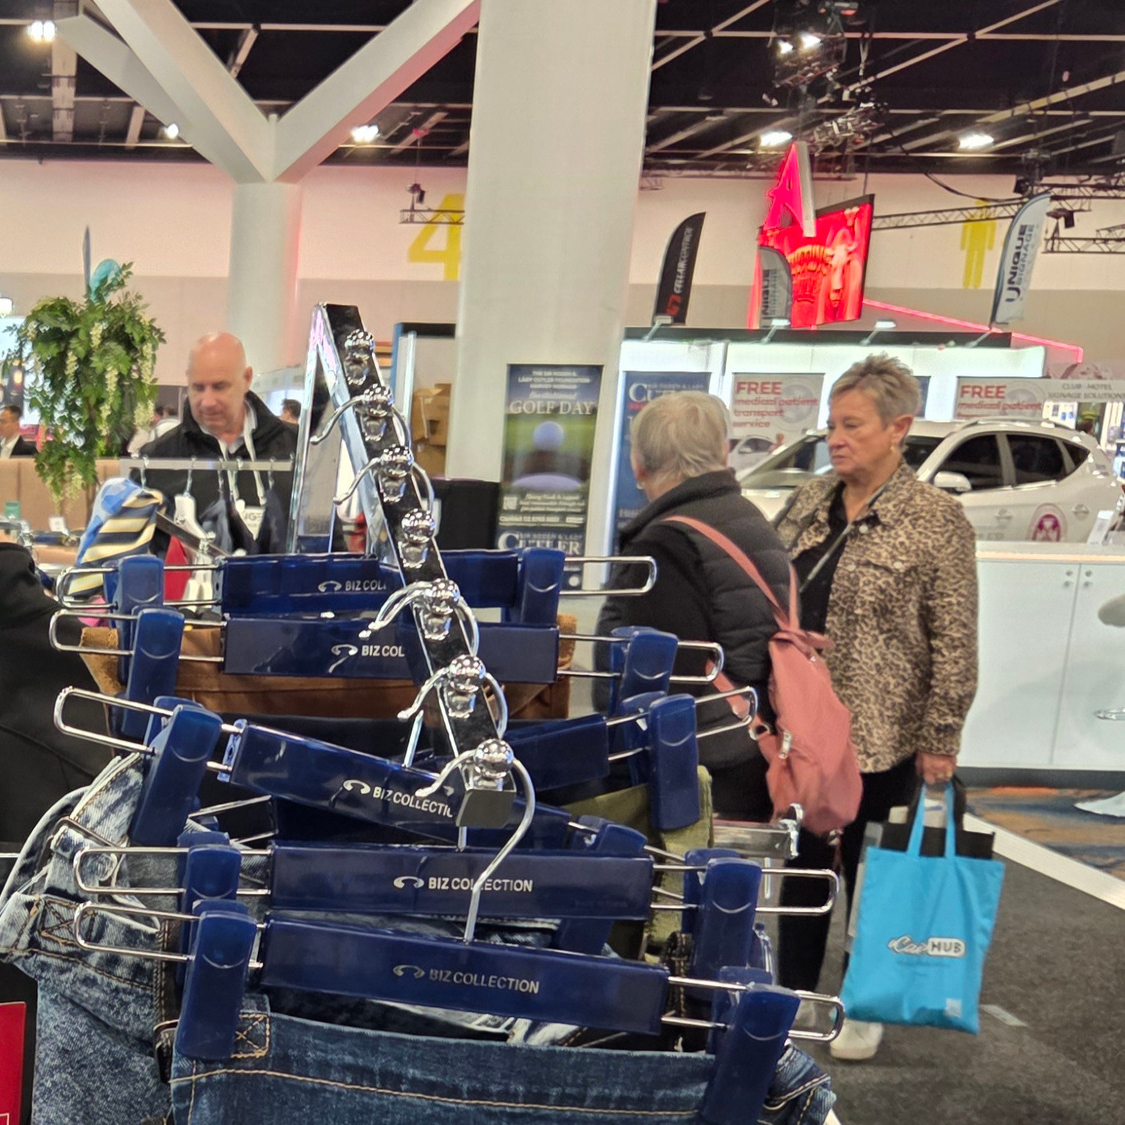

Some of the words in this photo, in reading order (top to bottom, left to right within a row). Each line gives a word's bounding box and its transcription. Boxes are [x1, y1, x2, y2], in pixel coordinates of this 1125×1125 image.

[408, 193, 466, 281] 4
[1016, 224, 1034, 285] SIGNAGE
[1005, 224, 1027, 303] UNIQUE
[736, 381, 783, 395] FREE
[960, 385, 1007, 399] FREE
[509, 400, 555, 415] GOLF
[559, 401, 595, 415] DAY
[734, 396, 776, 406] medical
[778, 397, 819, 408] patient
[957, 402, 1001, 411] medical
[1001, 402, 1042, 412] patient
[733, 409, 784, 418] transport
[732, 419, 771, 427] service
[345, 580, 361, 591] BIZ
[361, 645, 380, 656] BIZ
[373, 786, 393, 801] BIZ
[393, 791, 453, 818] COLLECTI
[428, 877, 449, 890] BIZ
[451, 877, 533, 892] COLECTION
[429, 968, 452, 983] BIZ
[453, 971, 540, 994] COLLECTION
